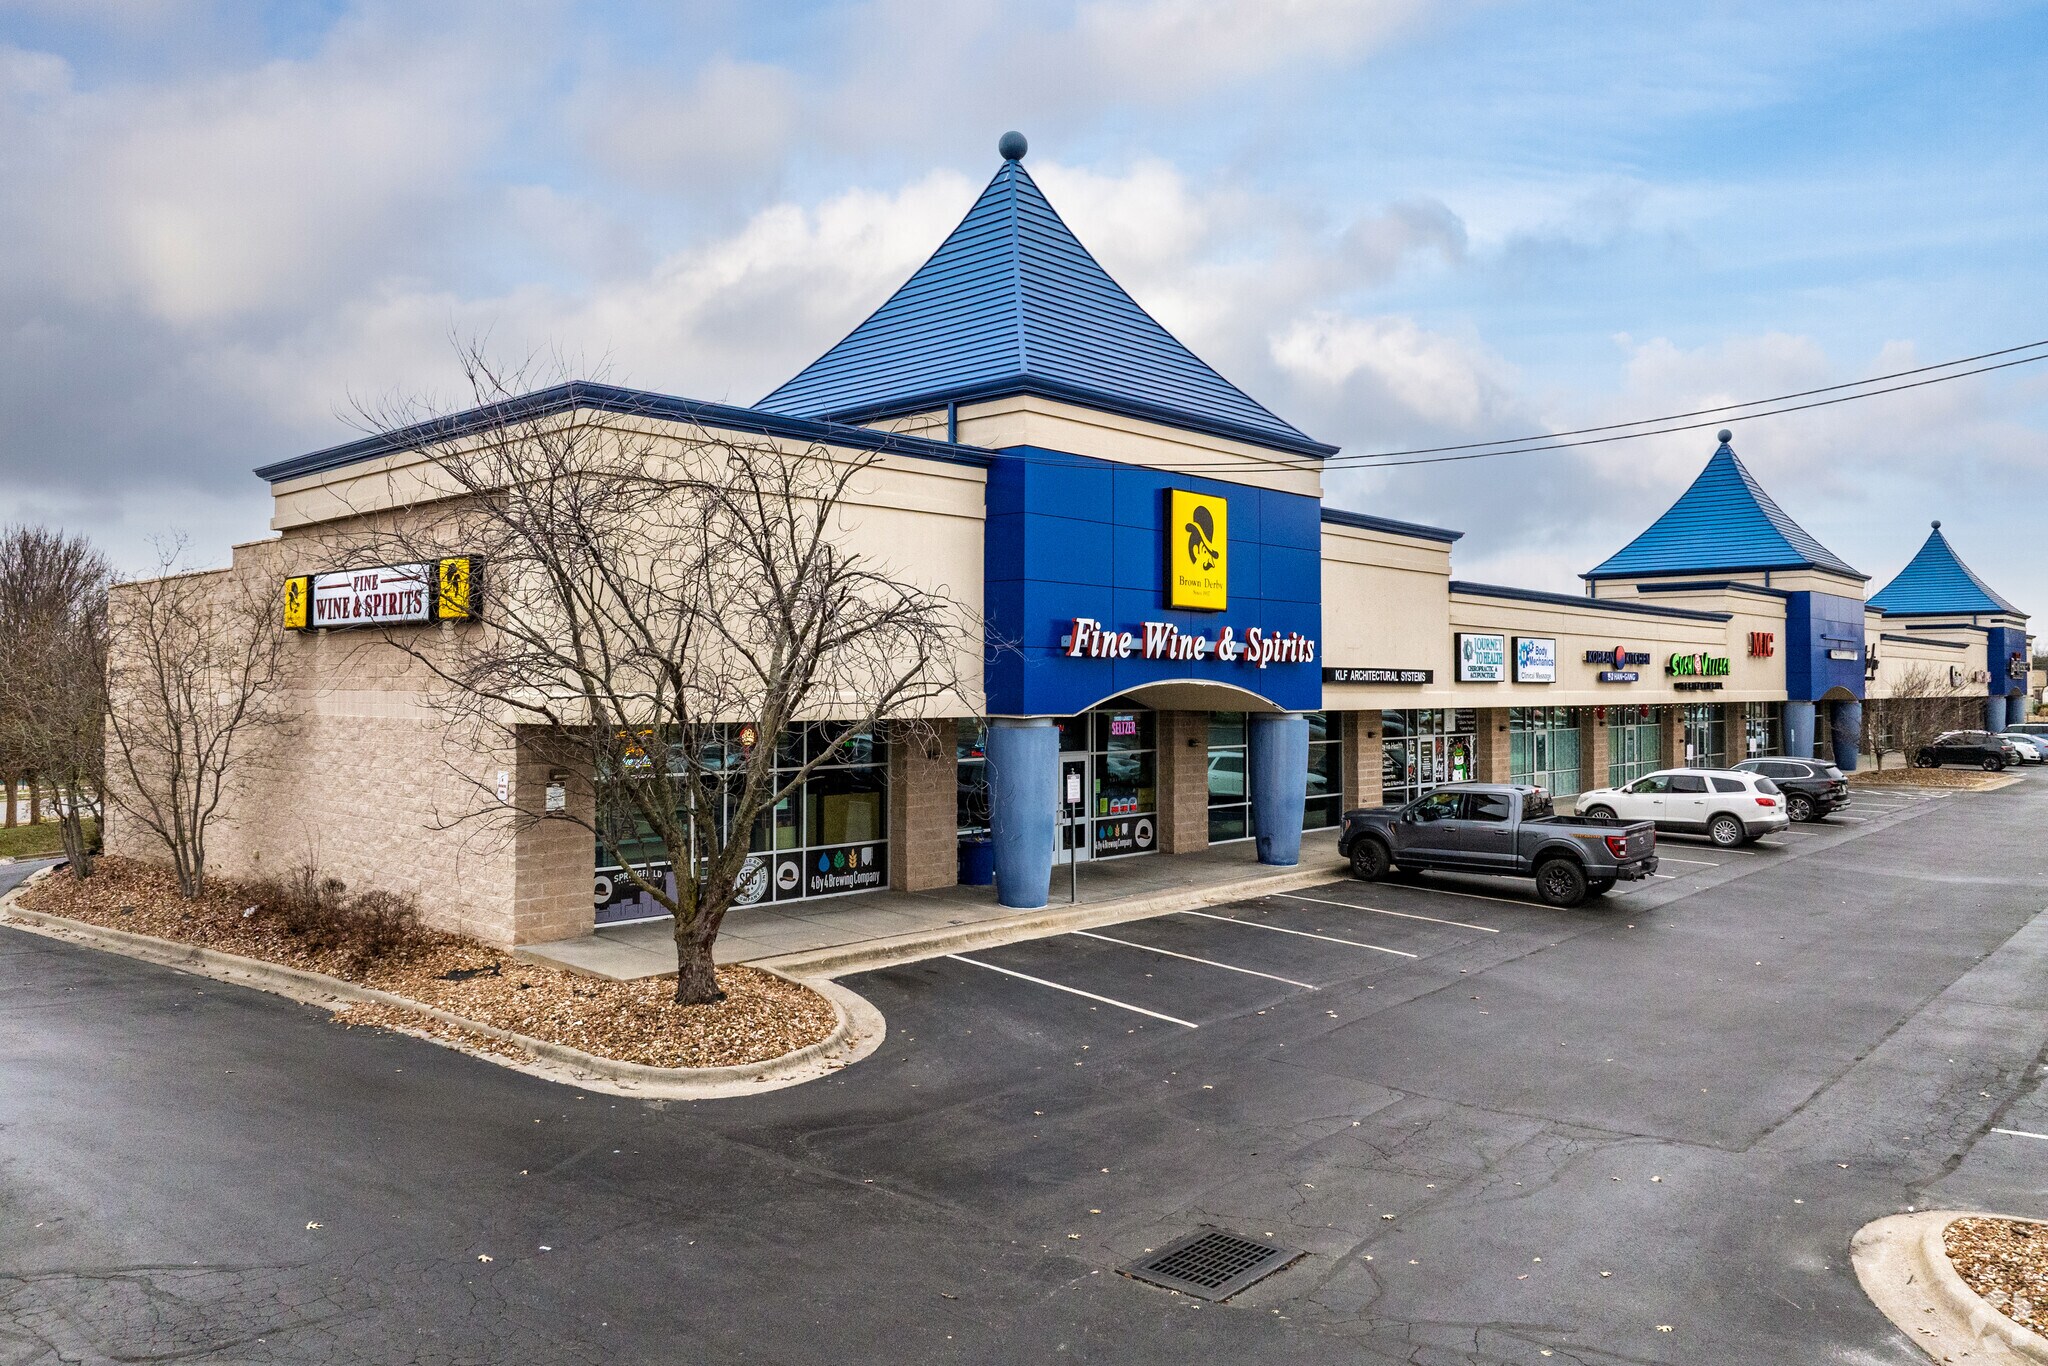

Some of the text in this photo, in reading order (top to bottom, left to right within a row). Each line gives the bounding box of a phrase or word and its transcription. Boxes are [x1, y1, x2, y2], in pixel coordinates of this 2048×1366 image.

[353, 574, 378, 592] FINE
[1179, 575, 1223, 590] Brown Derby
[316, 589, 422, 620] WINE & SPIRITS
[1066, 618, 1315, 669] Fine Wine & Spirits
[1474, 637, 1503, 653] JOURNEY
[1535, 645, 1548, 657] Body
[1750, 631, 1774, 657] MIC
[1474, 651, 1503, 665] TO HEALTH
[1529, 655, 1554, 667] Mechanics
[1587, 650, 1650, 665] KOREAN KITCHEN
[1335, 669, 1426, 682] KLF ARCHITECTURAL SYSTEMS
[1520, 671, 1552, 681] Clinical Massage
[1111, 721, 1136, 736] SELTZER
[613, 869, 663, 883] SPRGFILD
[811, 870, 880, 892] 4 By 4 Brewing Company
